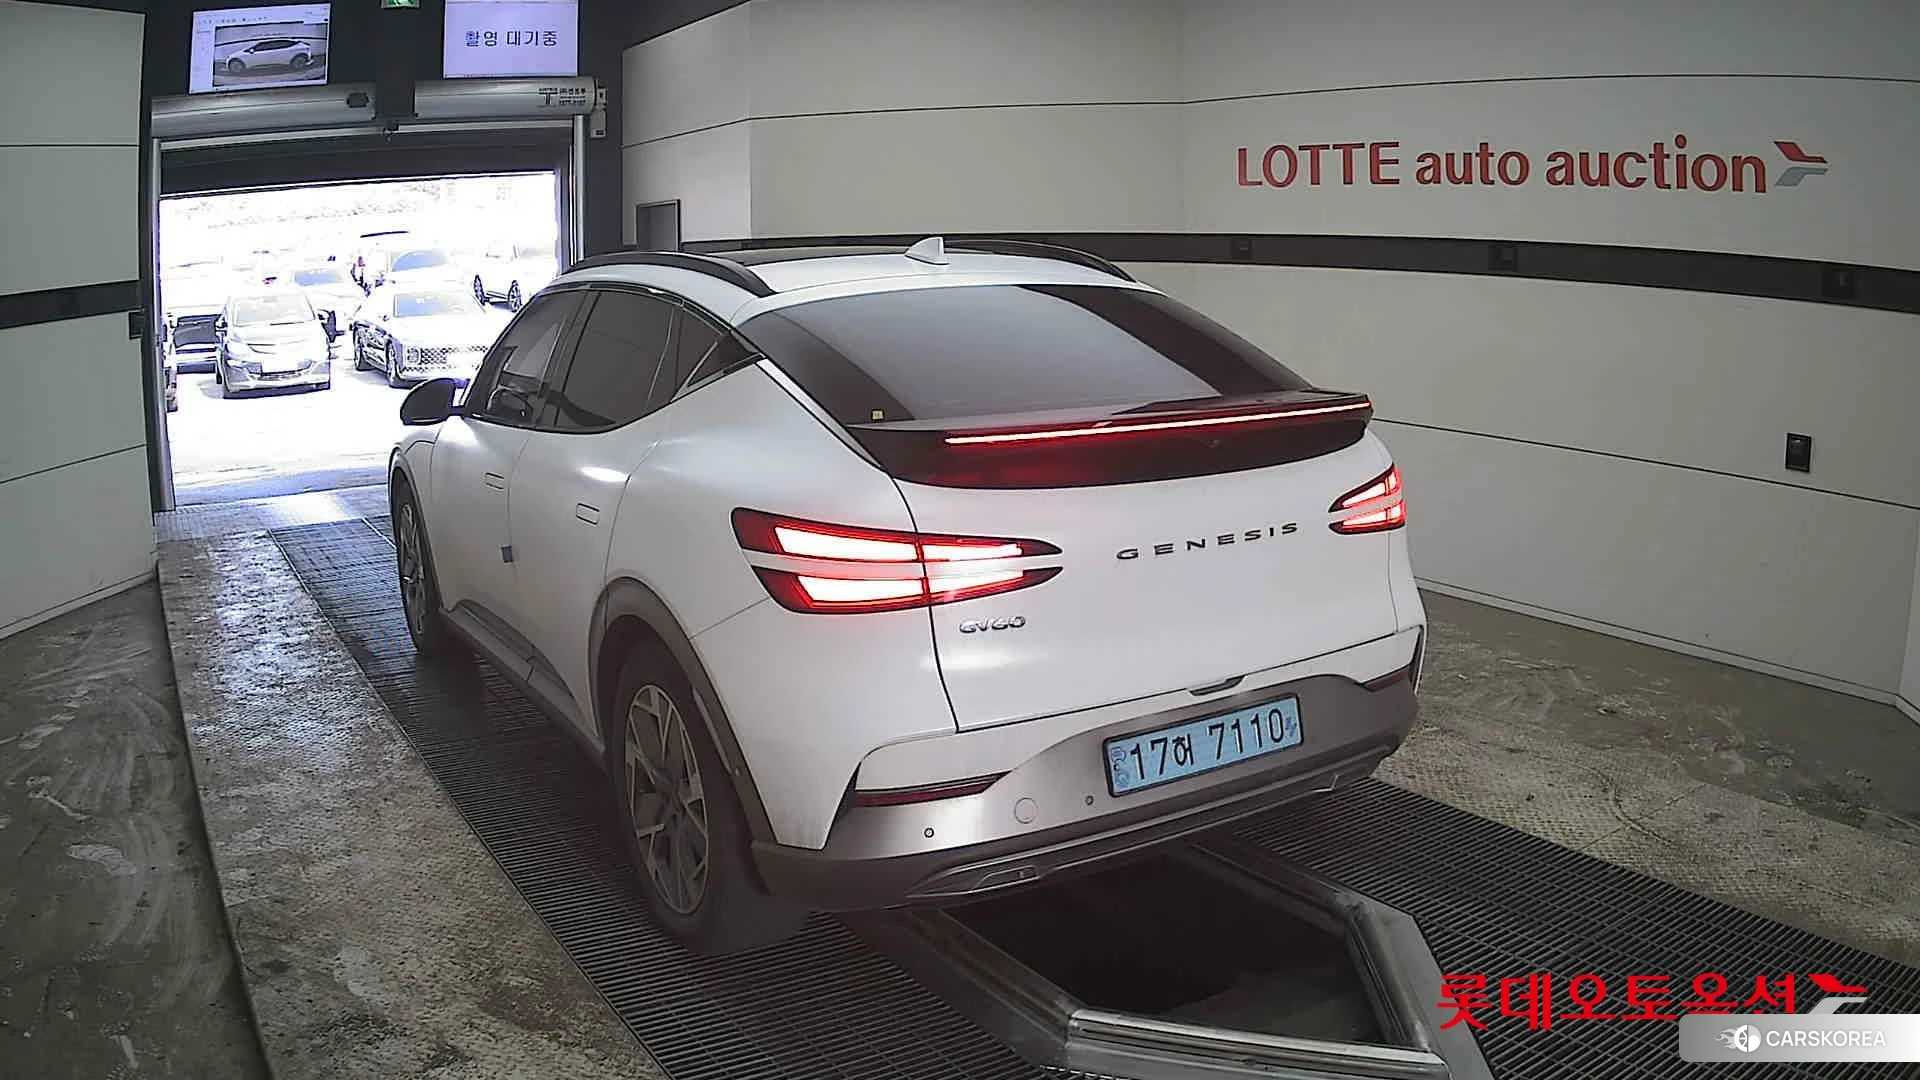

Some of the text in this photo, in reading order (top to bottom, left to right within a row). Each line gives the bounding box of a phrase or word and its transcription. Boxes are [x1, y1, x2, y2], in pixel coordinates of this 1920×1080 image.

[506, 30, 558, 47] 대기중
[1237, 133, 1768, 194] LOTTE auto auction
[1116, 522, 1298, 560] GENESIS
[959, 615, 1026, 634] GV60
[1130, 707, 1284, 780] 17허 7110
